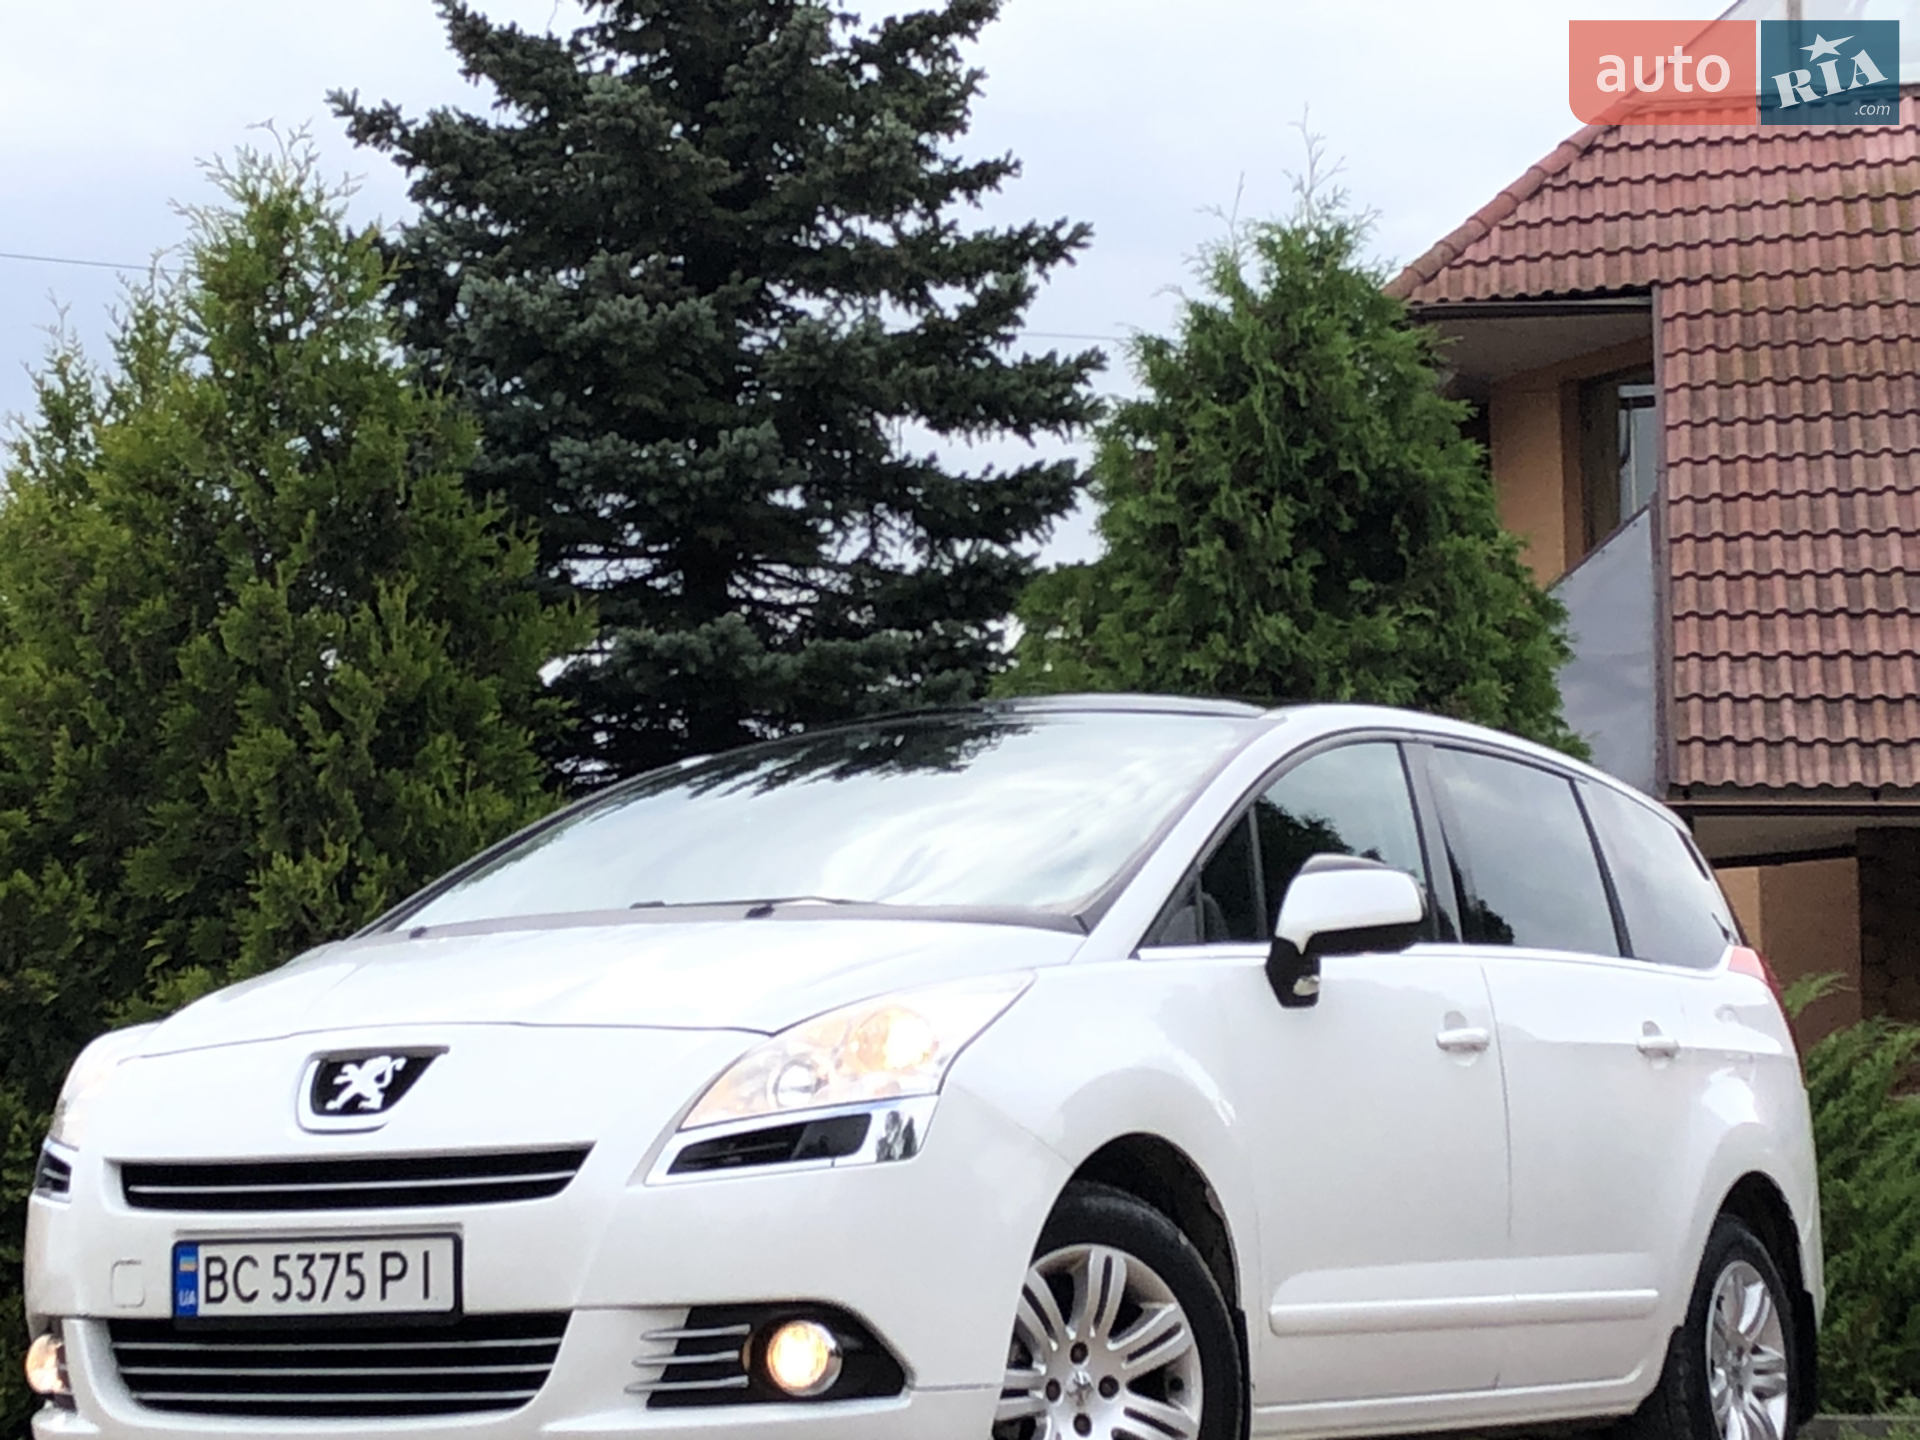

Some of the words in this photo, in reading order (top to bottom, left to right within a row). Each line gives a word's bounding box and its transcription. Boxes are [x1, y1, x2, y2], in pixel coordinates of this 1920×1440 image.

[204, 1255, 259, 1304] BC
[271, 1251, 366, 1302] 5375
[178, 1290, 196, 1306] UA
